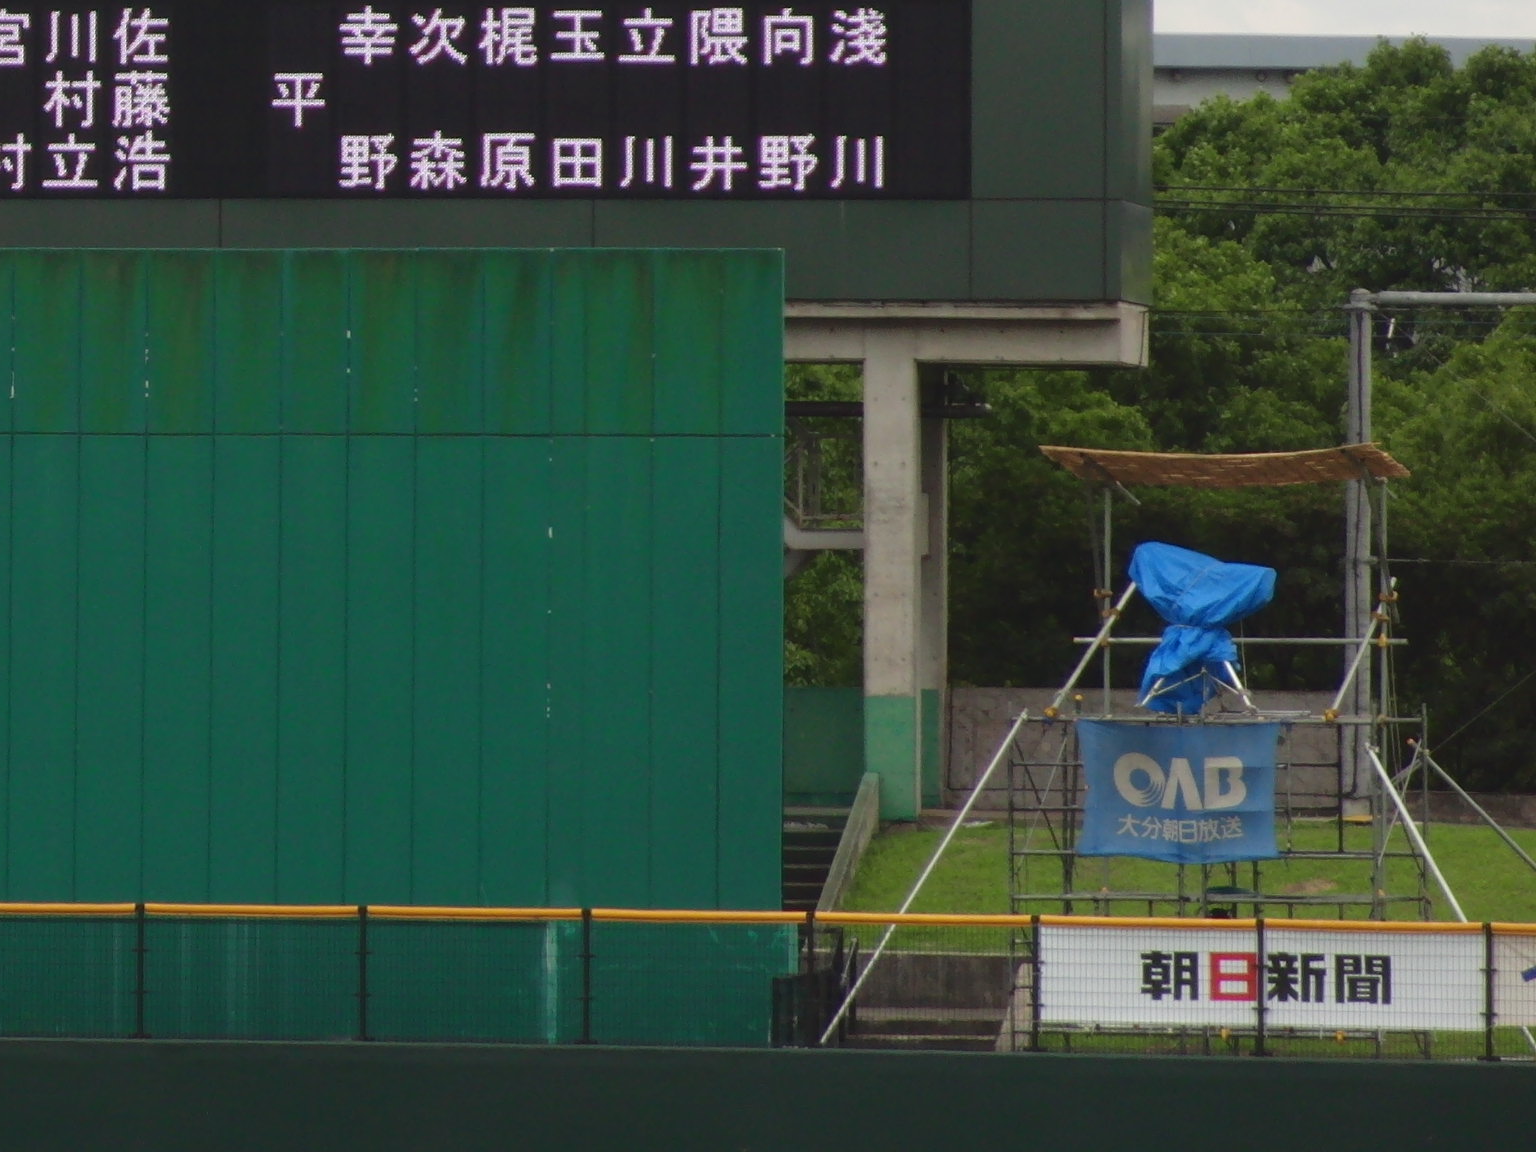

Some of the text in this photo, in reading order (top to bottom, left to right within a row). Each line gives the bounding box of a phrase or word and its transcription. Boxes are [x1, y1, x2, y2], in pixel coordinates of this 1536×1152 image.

[271, 72, 326, 127] 平
[1112, 752, 1248, 810] OAB
[1116, 814, 1245, 844] 大分朝日放送
[1140, 950, 1393, 1005] 朝日新聞
